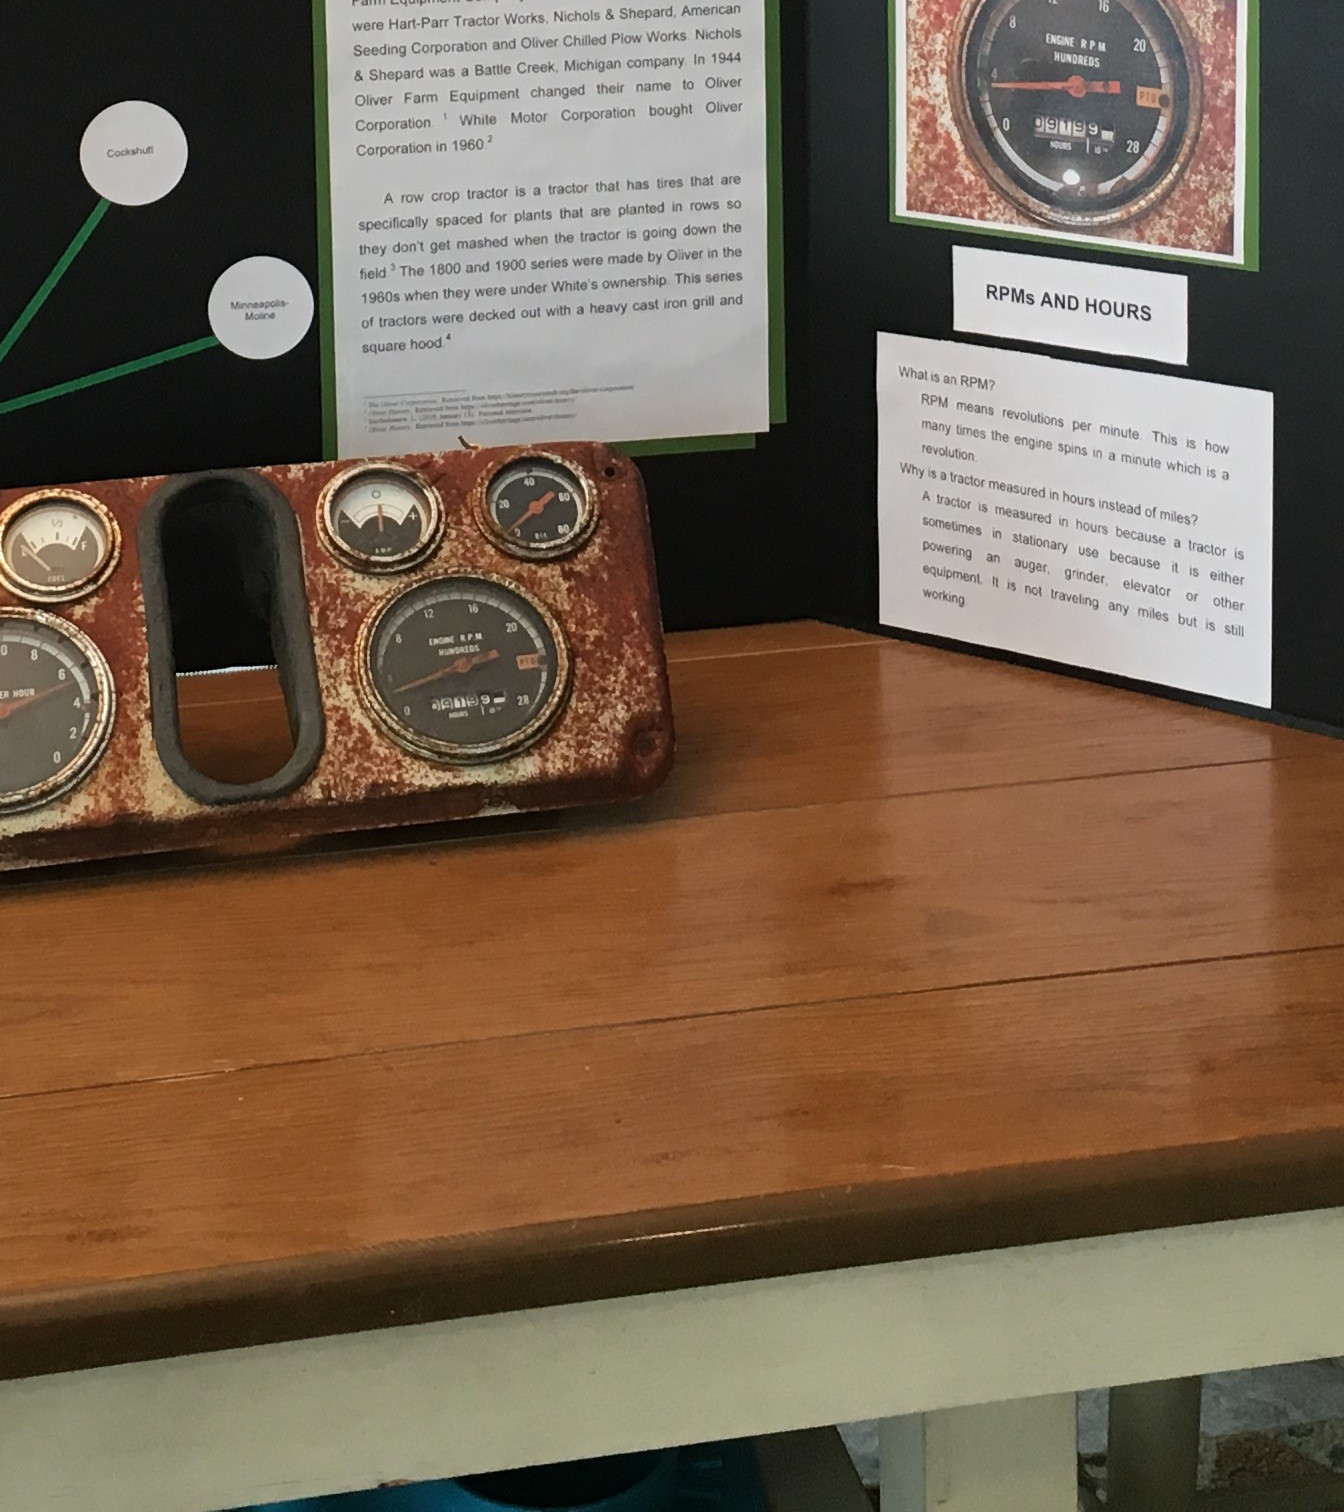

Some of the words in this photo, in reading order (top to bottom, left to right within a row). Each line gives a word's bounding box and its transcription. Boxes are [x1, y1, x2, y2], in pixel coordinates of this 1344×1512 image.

[352, 43, 407, 58] Seeding
[410, 40, 488, 56] Corporation
[492, 37, 516, 51] and
[520, 36, 559, 50] Oliver
[562, 33, 607, 48] Chilled
[610, 32, 642, 45] Plow
[694, 26, 742, 40] Nichols
[1046, 33, 1074, 48] ENGINE
[1134, 38, 1146, 52] 20
[1054, 52, 1100, 68] HUNDREDS
[1139, 91, 1156, 104] PTO
[1126, 140, 1140, 154] 28
[230, 299, 289, 310] Minneapolis-
[985, 282, 1035, 308] RPMs
[1040, 290, 1079, 313] AND
[1084, 297, 1153, 323] HOURS
[245, 312, 275, 320] Moline
[898, 365, 928, 382] What
[930, 372, 940, 383] is
[942, 374, 957, 386] an
[960, 374, 996, 391] RPM?
[506, 622, 518, 632] 20
[12, 688, 36, 698] HOUR
[517, 694, 530, 706] 28
